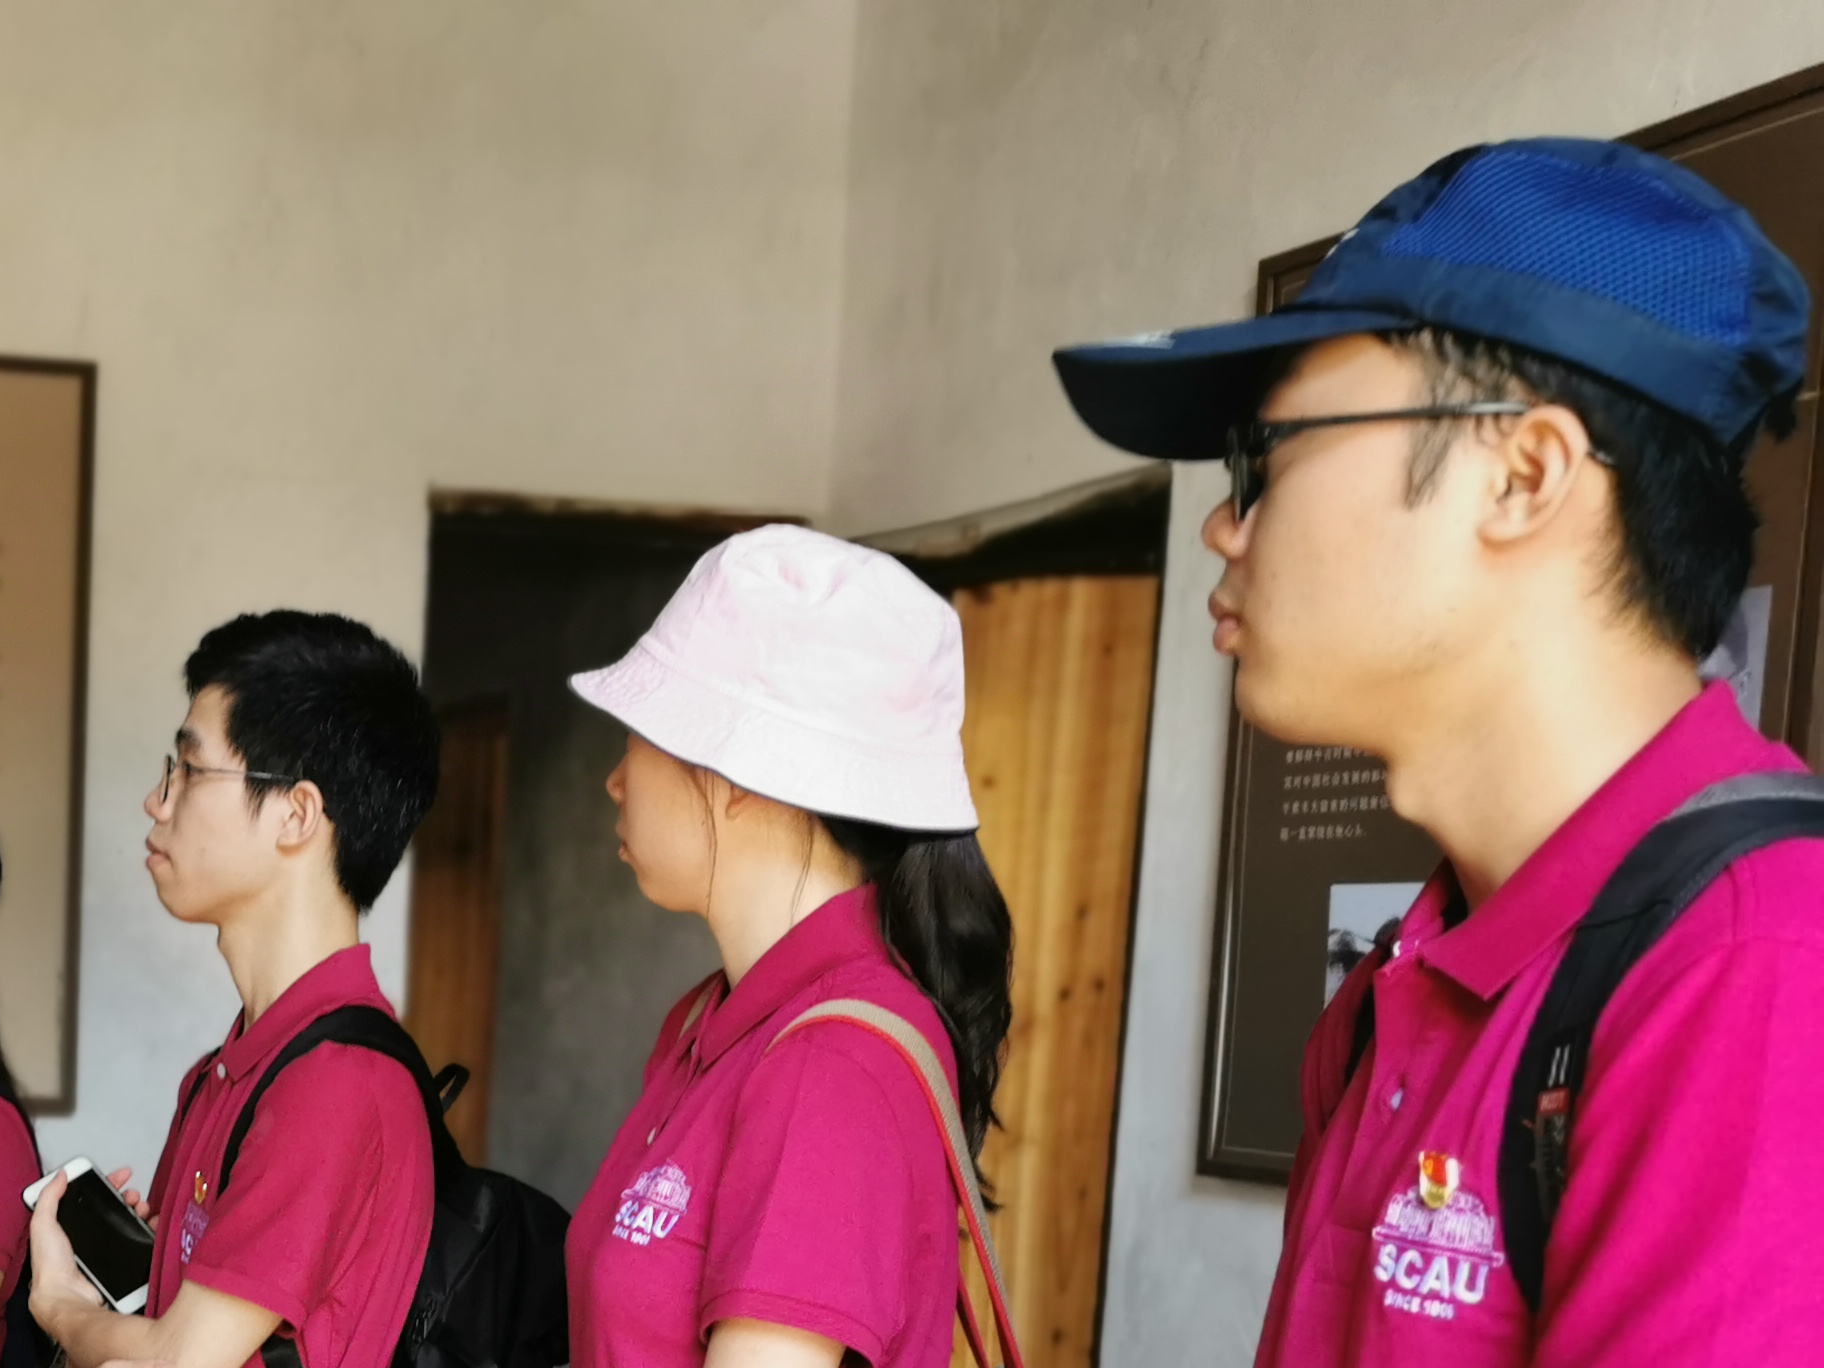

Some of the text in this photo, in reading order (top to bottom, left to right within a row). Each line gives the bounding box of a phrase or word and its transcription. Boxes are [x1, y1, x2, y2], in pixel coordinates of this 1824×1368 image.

[615, 1200, 680, 1239] SCAU
[1374, 1243, 1489, 1304] SCAU
[1384, 1288, 1421, 1314] SINCE
